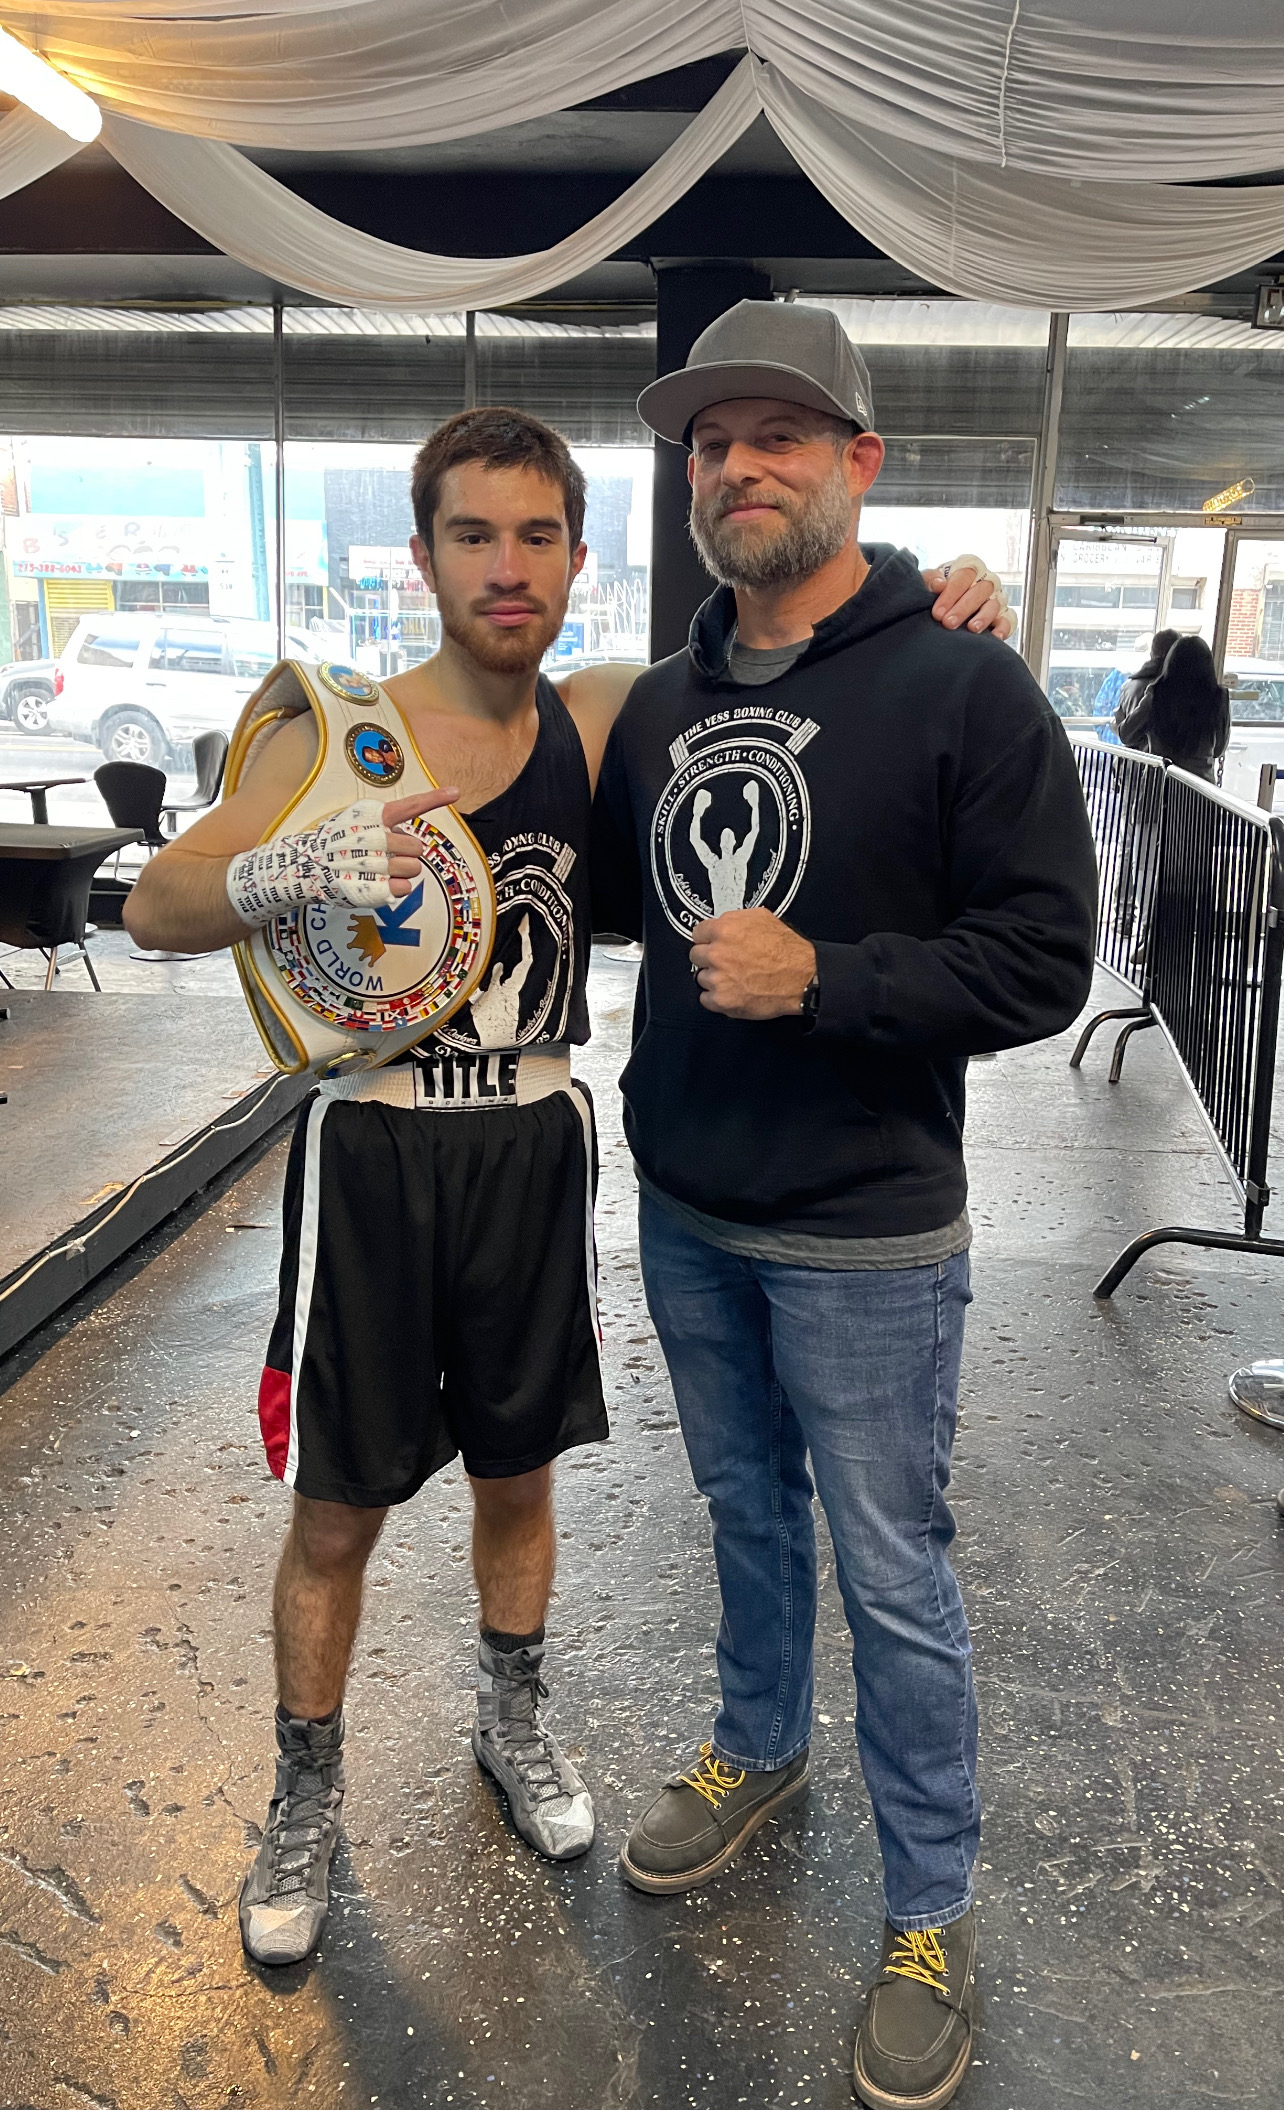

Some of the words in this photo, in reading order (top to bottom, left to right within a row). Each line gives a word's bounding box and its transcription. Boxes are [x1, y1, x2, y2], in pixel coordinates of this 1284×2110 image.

[683, 721, 703, 740] THE
[704, 710, 730, 728] YESS
[733, 706, 774, 719] BOXING
[775, 710, 802, 729] CLUB
[657, 794, 677, 834] SKILL
[678, 749, 741, 789] STRENGTH
[748, 749, 799, 821] CONDITIONING
[316, 938, 384, 992] WORLD
[415, 1054, 518, 1099] TITLE
